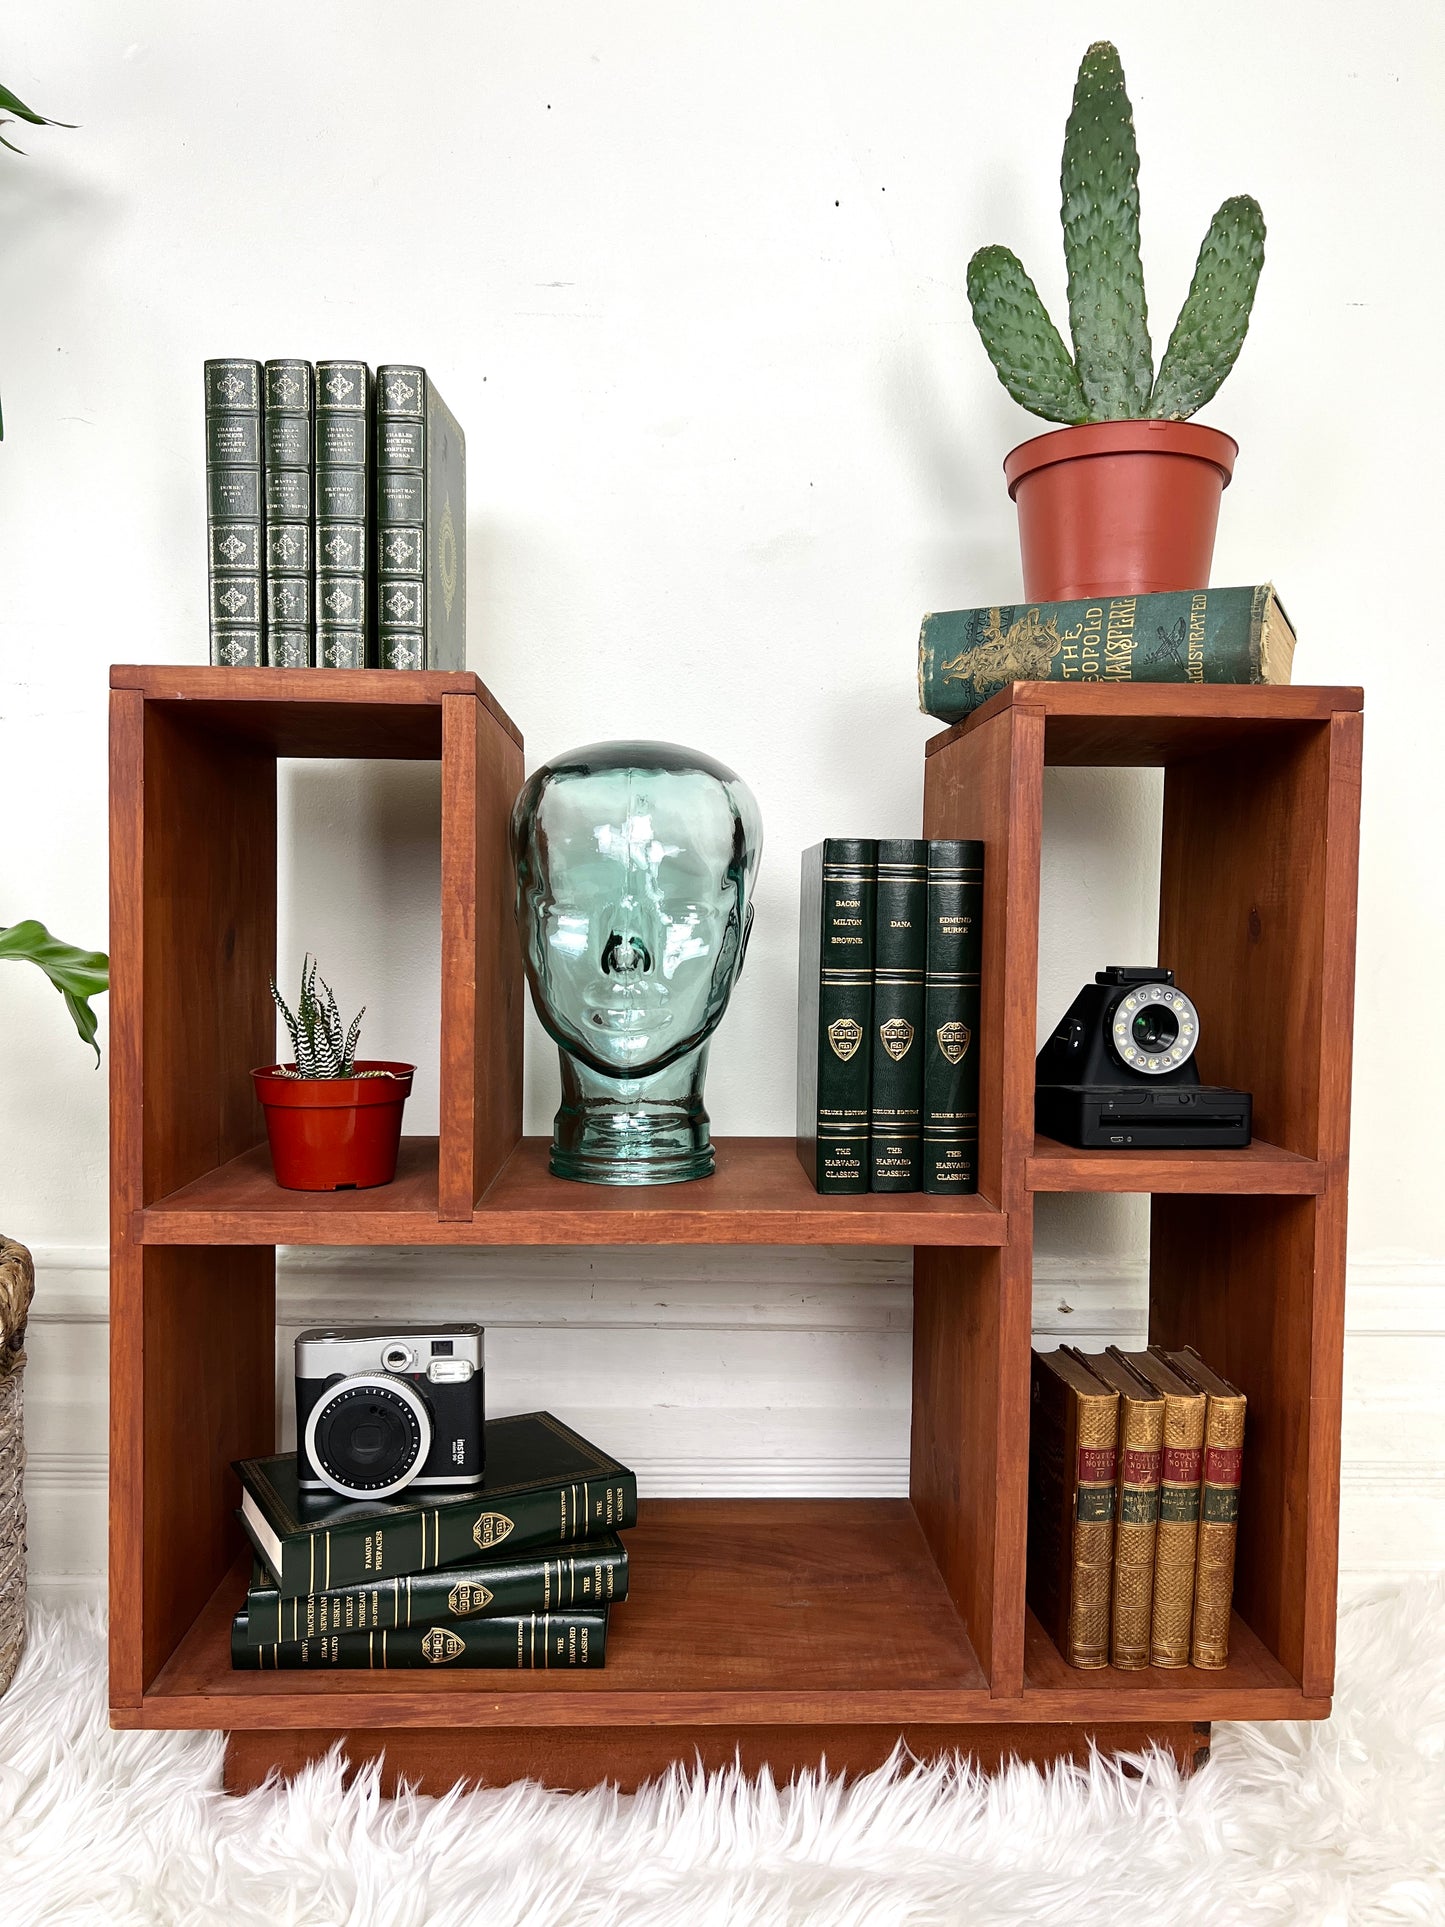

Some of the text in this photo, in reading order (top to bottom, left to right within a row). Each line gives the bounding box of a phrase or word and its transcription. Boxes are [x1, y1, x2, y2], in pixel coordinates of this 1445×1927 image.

[1061, 622, 1083, 679] THE
[825, 1159, 860, 1167] HARVARD
[876, 1158, 911, 1166] HARVARD
[937, 1173, 970, 1181] CLASSICS
[456, 1439, 465, 1465] instax
[1130, 1462, 1159, 1470] NOVELS
[1170, 1460, 1198, 1468] NOVELS
[320, 1596, 328, 1631] NEWMAN
[333, 1598, 341, 1628] RUSKIN
[346, 1596, 354, 1627] HUXLEY
[359, 1592, 367, 1628] THOREAU
[581, 1627, 589, 1663] CLASSICS
